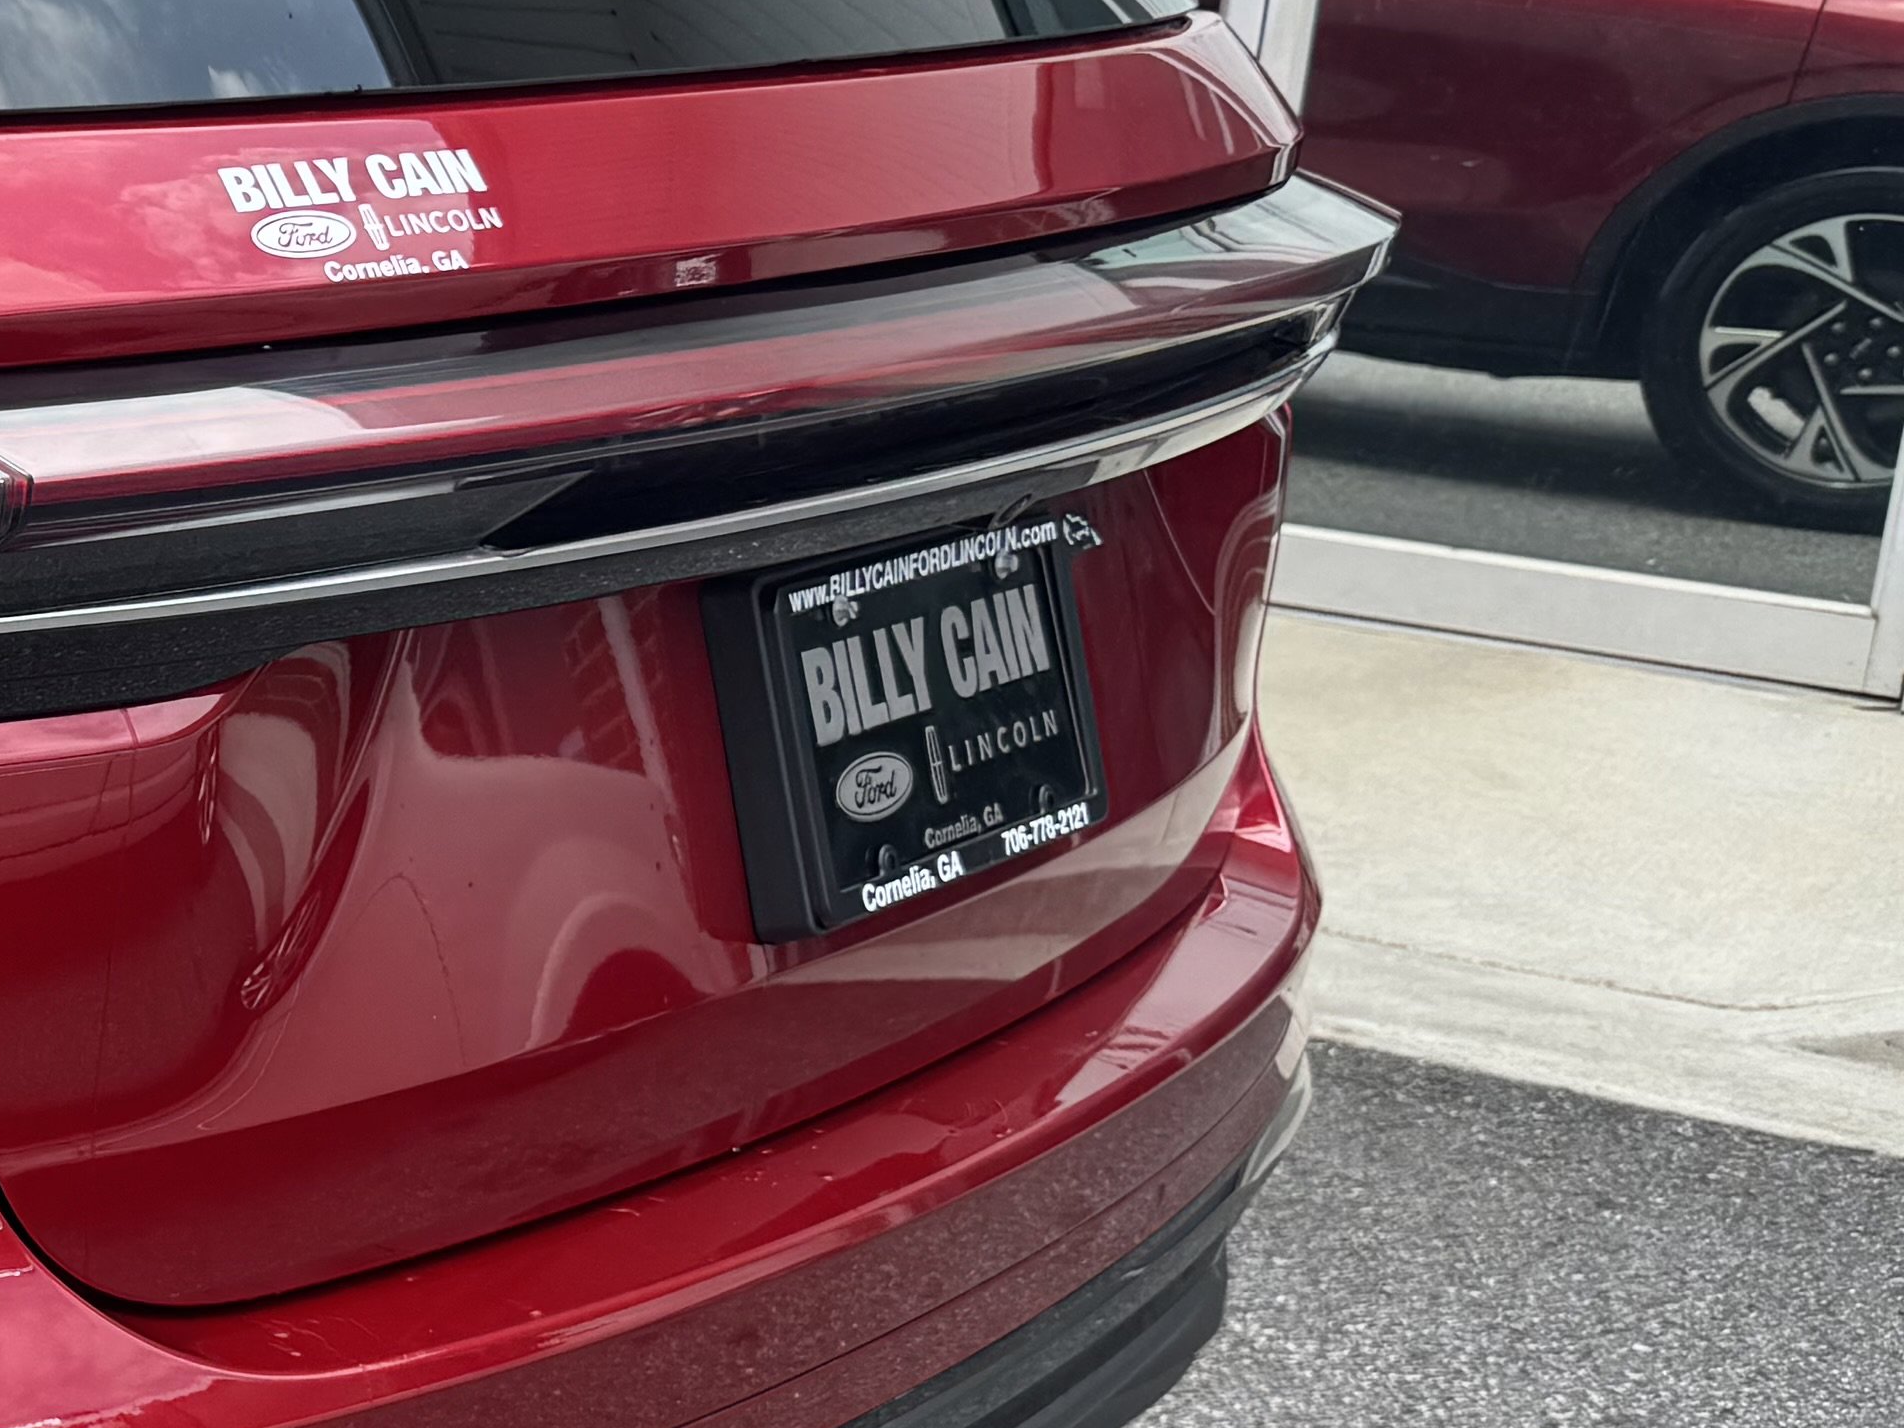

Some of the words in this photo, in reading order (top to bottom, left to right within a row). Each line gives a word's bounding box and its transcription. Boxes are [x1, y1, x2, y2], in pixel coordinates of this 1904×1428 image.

[217, 157, 357, 214] BILLY
[364, 148, 488, 200] CAIN
[277, 221, 334, 249] Ford
[382, 206, 504, 238] LINCOLN
[431, 248, 470, 273] GA
[788, 520, 1058, 613] www.BILLYCAINFORDLINCOLN.com
[800, 615, 933, 748] BILLY
[939, 583, 1051, 700] CAIN
[853, 766, 898, 809] Ford
[947, 708, 1059, 773] LINCOLN
[923, 813, 983, 850] Cornelia,
[983, 801, 1004, 828] GA
[1000, 801, 1090, 857] 706-778-2121
[861, 864, 937, 913] Cornelia,
[936, 850, 965, 883] GA
